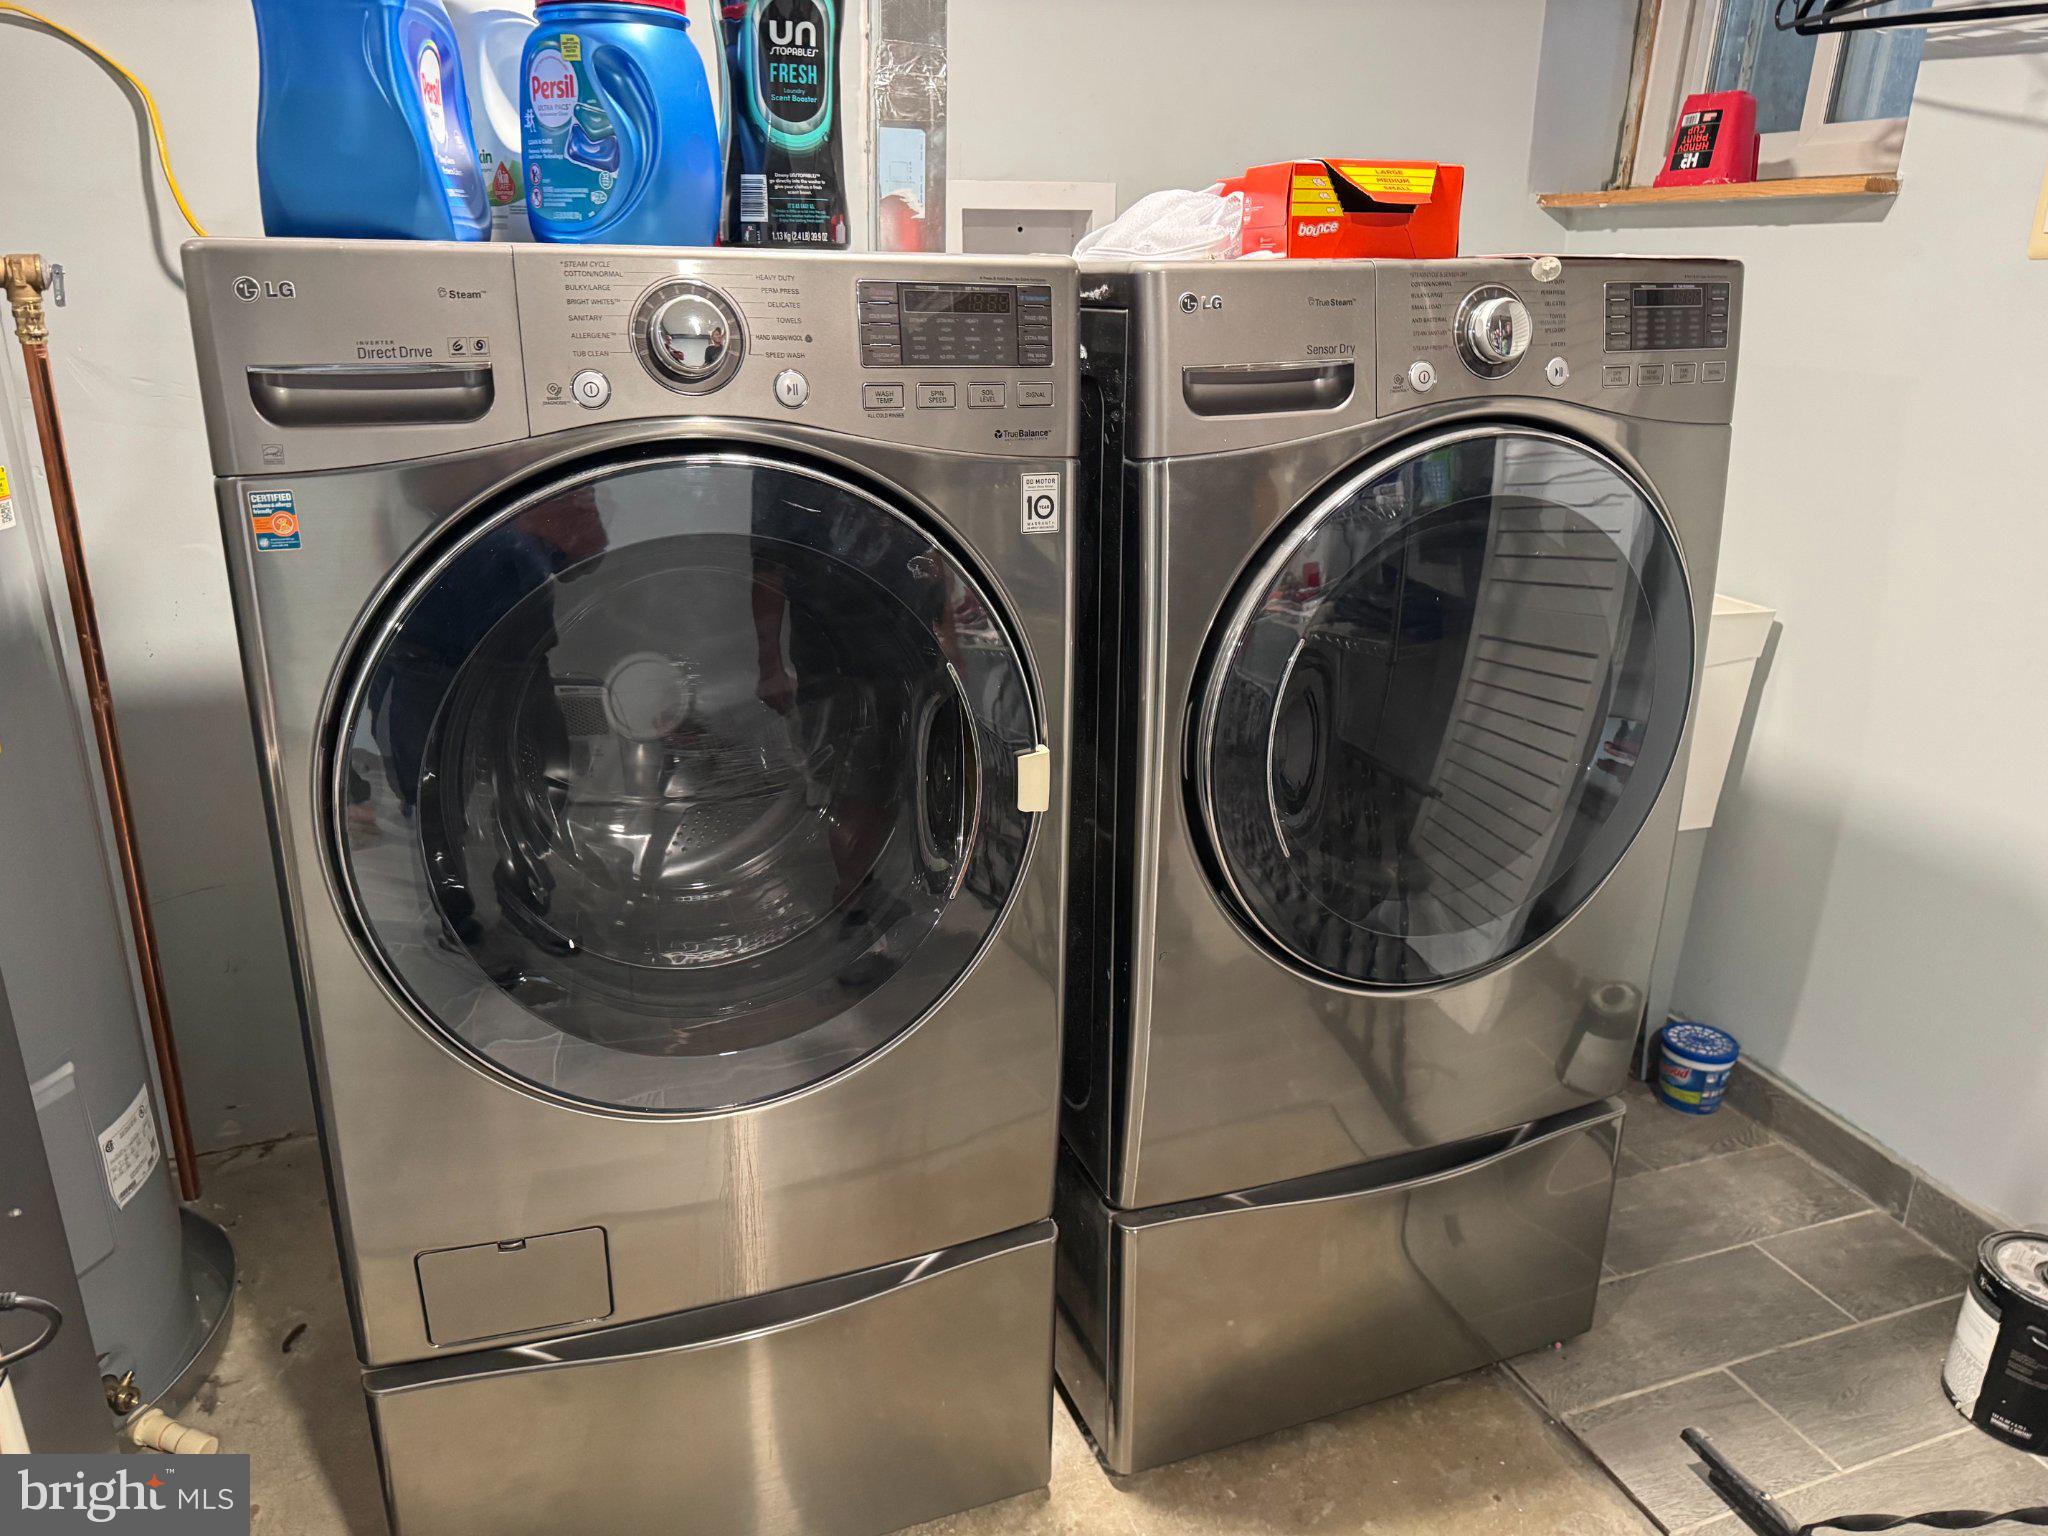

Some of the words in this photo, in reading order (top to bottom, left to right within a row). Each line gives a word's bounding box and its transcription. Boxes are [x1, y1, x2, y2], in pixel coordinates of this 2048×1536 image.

[770, 63, 817, 85] FRESH
[421, 73, 441, 106] Persil
[531, 74, 576, 102] Persil
[791, 95, 817, 103] Booster
[1688, 125, 1706, 134] CUP
[1681, 133, 1709, 144] PAINT
[1678, 141, 1709, 152] HANDY
[1297, 221, 1339, 238] bounce
[771, 232, 783, 240] 1.13
[783, 232, 791, 242] Kg
[563, 270, 624, 278] COTTON/NORMAL
[264, 281, 296, 299] LG
[767, 301, 801, 309] DELICATES
[1201, 295, 1223, 311] LG
[568, 314, 603, 322] SANITARY
[357, 346, 397, 359] Direct
[399, 345, 433, 358] Drive
[1306, 344, 1338, 355] Sensor
[1338, 343, 1356, 356] Dry
[250, 493, 292, 503] CERTIFIED
[1026, 494, 1055, 520] 10
